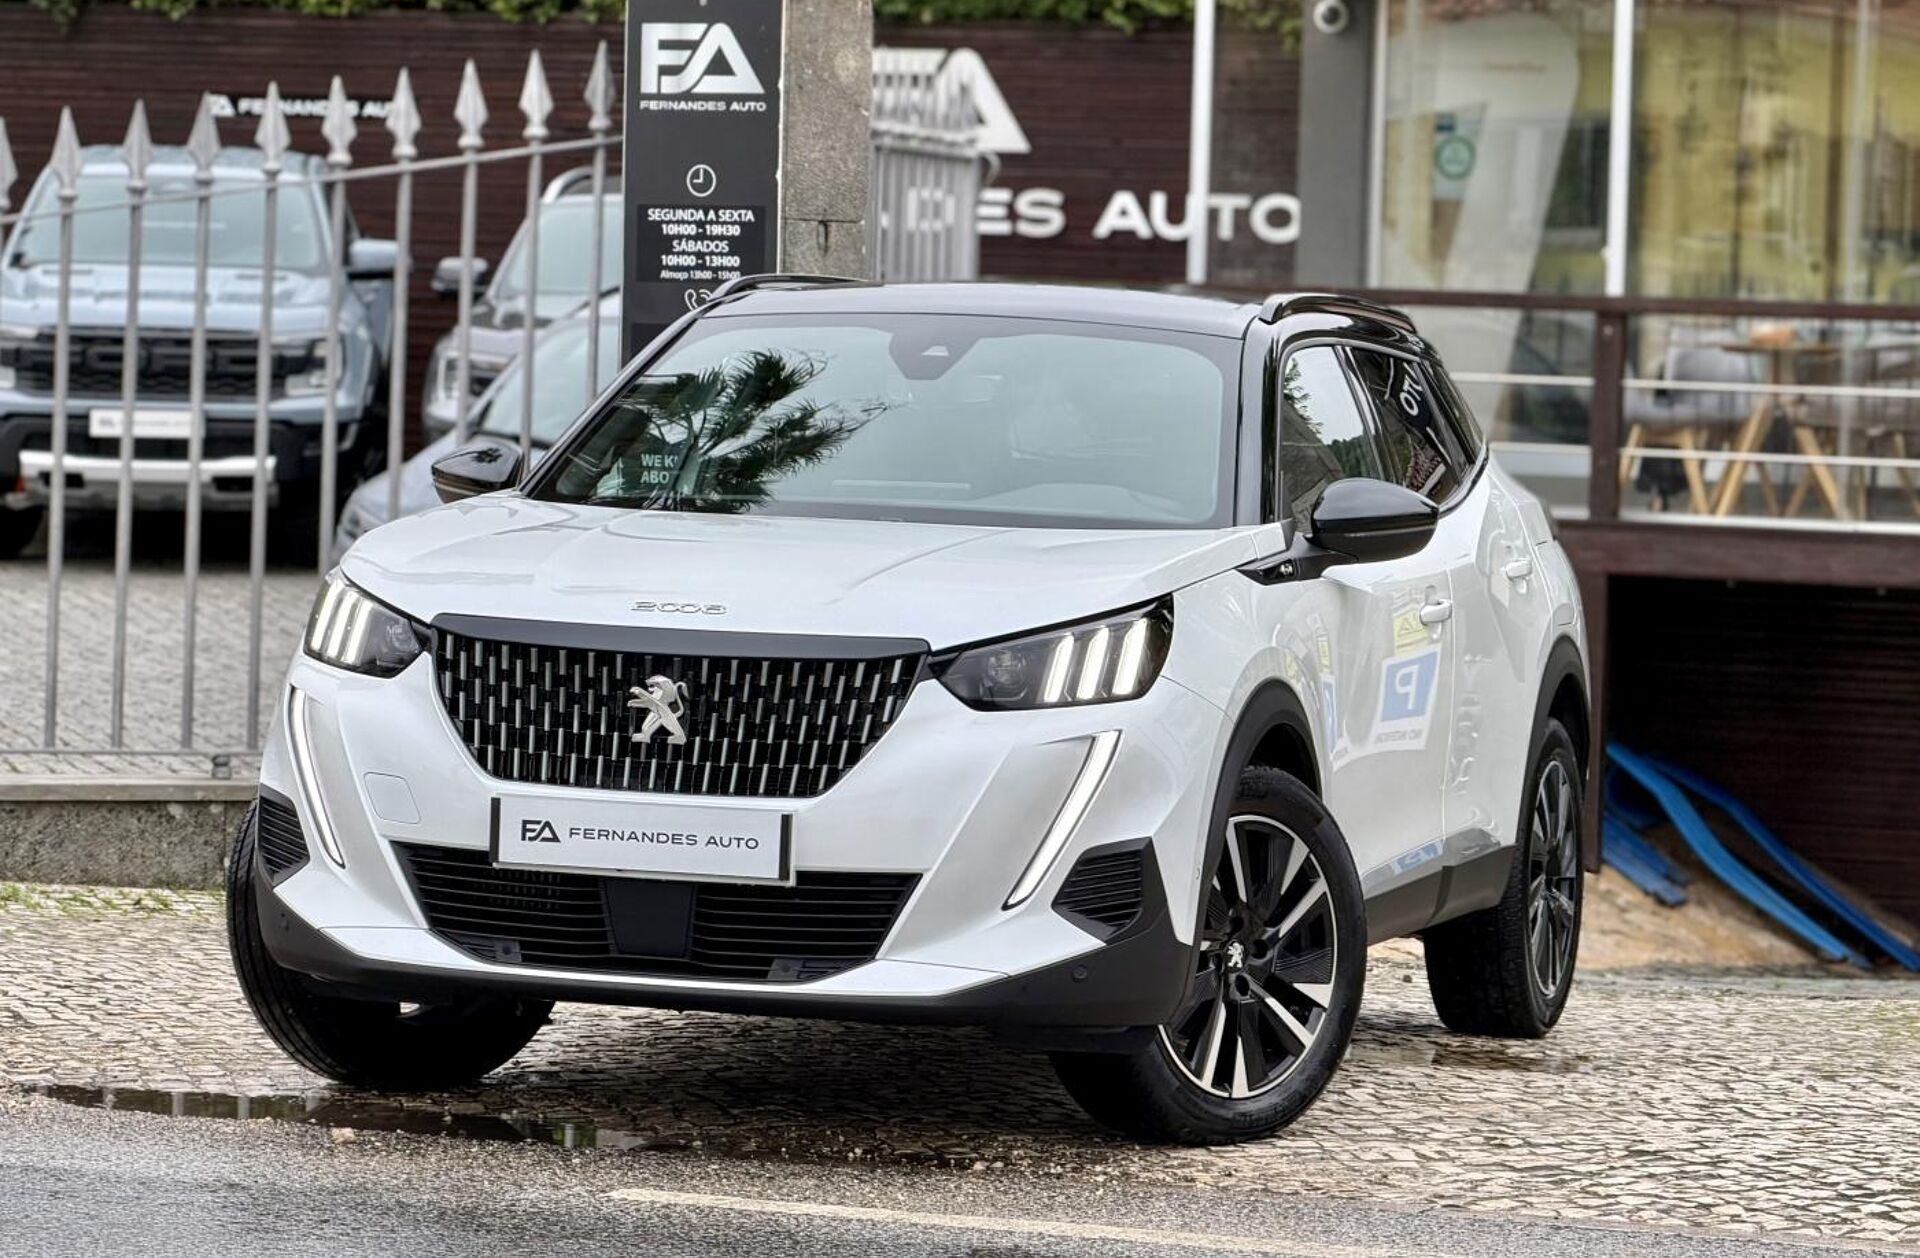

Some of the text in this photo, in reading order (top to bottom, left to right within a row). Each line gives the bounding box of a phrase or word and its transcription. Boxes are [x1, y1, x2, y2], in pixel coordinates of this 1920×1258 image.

[640, 22, 766, 95] FA
[640, 100, 767, 112] FERNANDES AUTO
[647, 208, 755, 222] SEGUNDA A SEXTA
[1092, 190, 1302, 244] AUTO
[661, 224, 697, 236] 10H00
[705, 224, 741, 236] 19H30
[672, 238, 729, 253] SÁBADOS
[661, 255, 697, 267] 10H00
[705, 256, 741, 267] 13H00
[660, 269, 689, 281] Almoço
[641, 453, 661, 467] WE
[631, 600, 727, 615] 2008
[521, 819, 759, 850] FA FERNANDES AUTO
